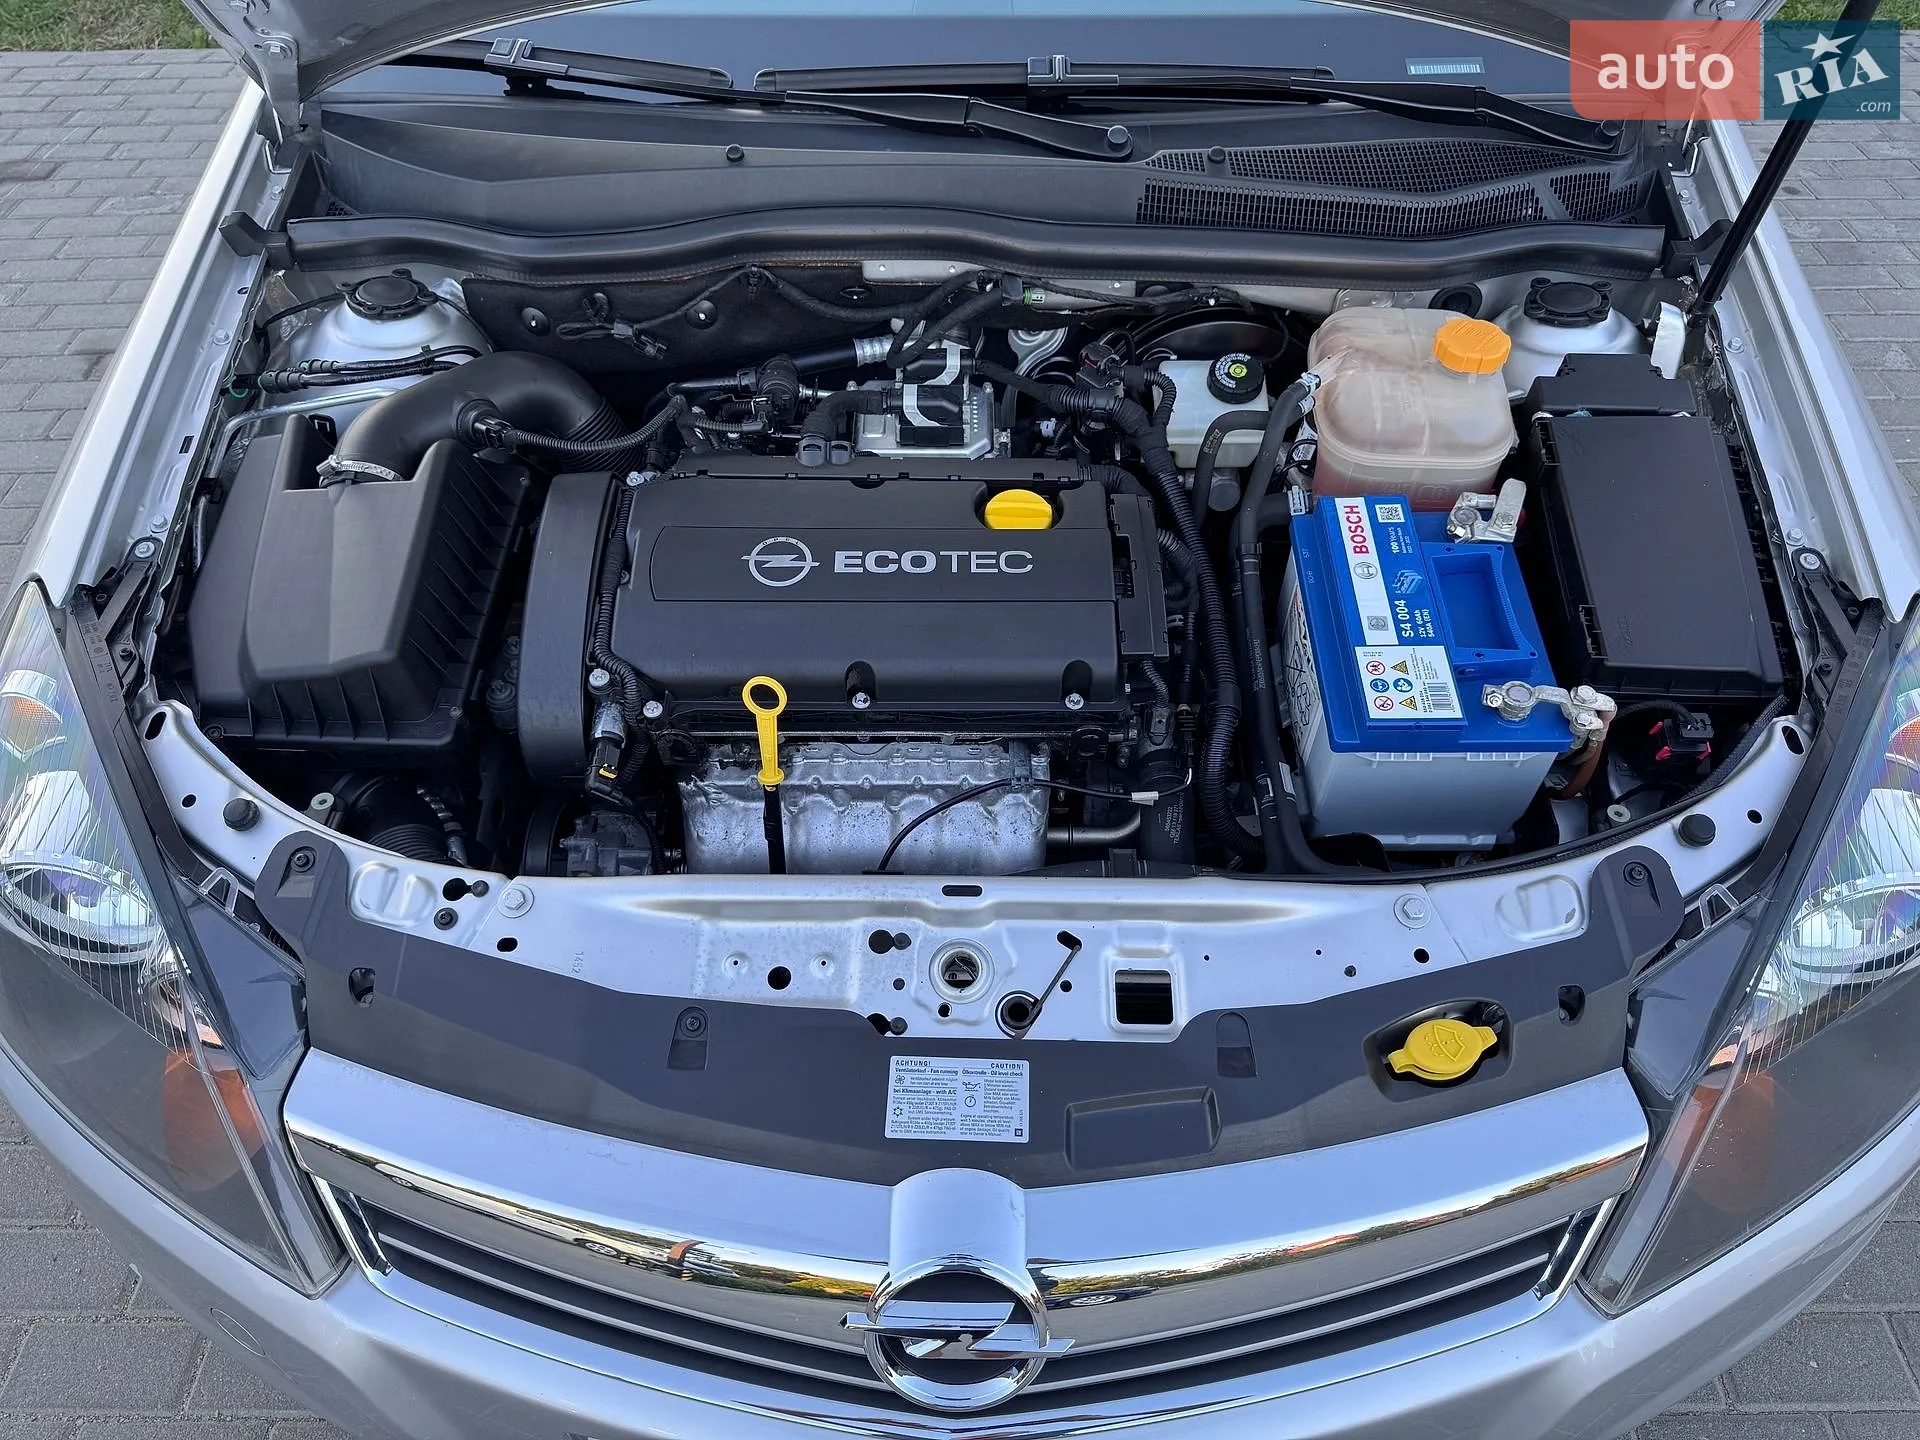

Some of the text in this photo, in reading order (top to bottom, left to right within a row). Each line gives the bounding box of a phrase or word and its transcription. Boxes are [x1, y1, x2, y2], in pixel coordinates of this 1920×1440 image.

[1343, 505, 1370, 554] BOSCH
[1388, 526, 1400, 554] 100 Years
[834, 550, 1034, 574] ECOTEC
[1394, 599, 1410, 620] 004
[1413, 609, 1427, 638] 12V 60Ah
[1421, 608, 1435, 638] 540A (EN)
[1400, 622, 1414, 638] S4
